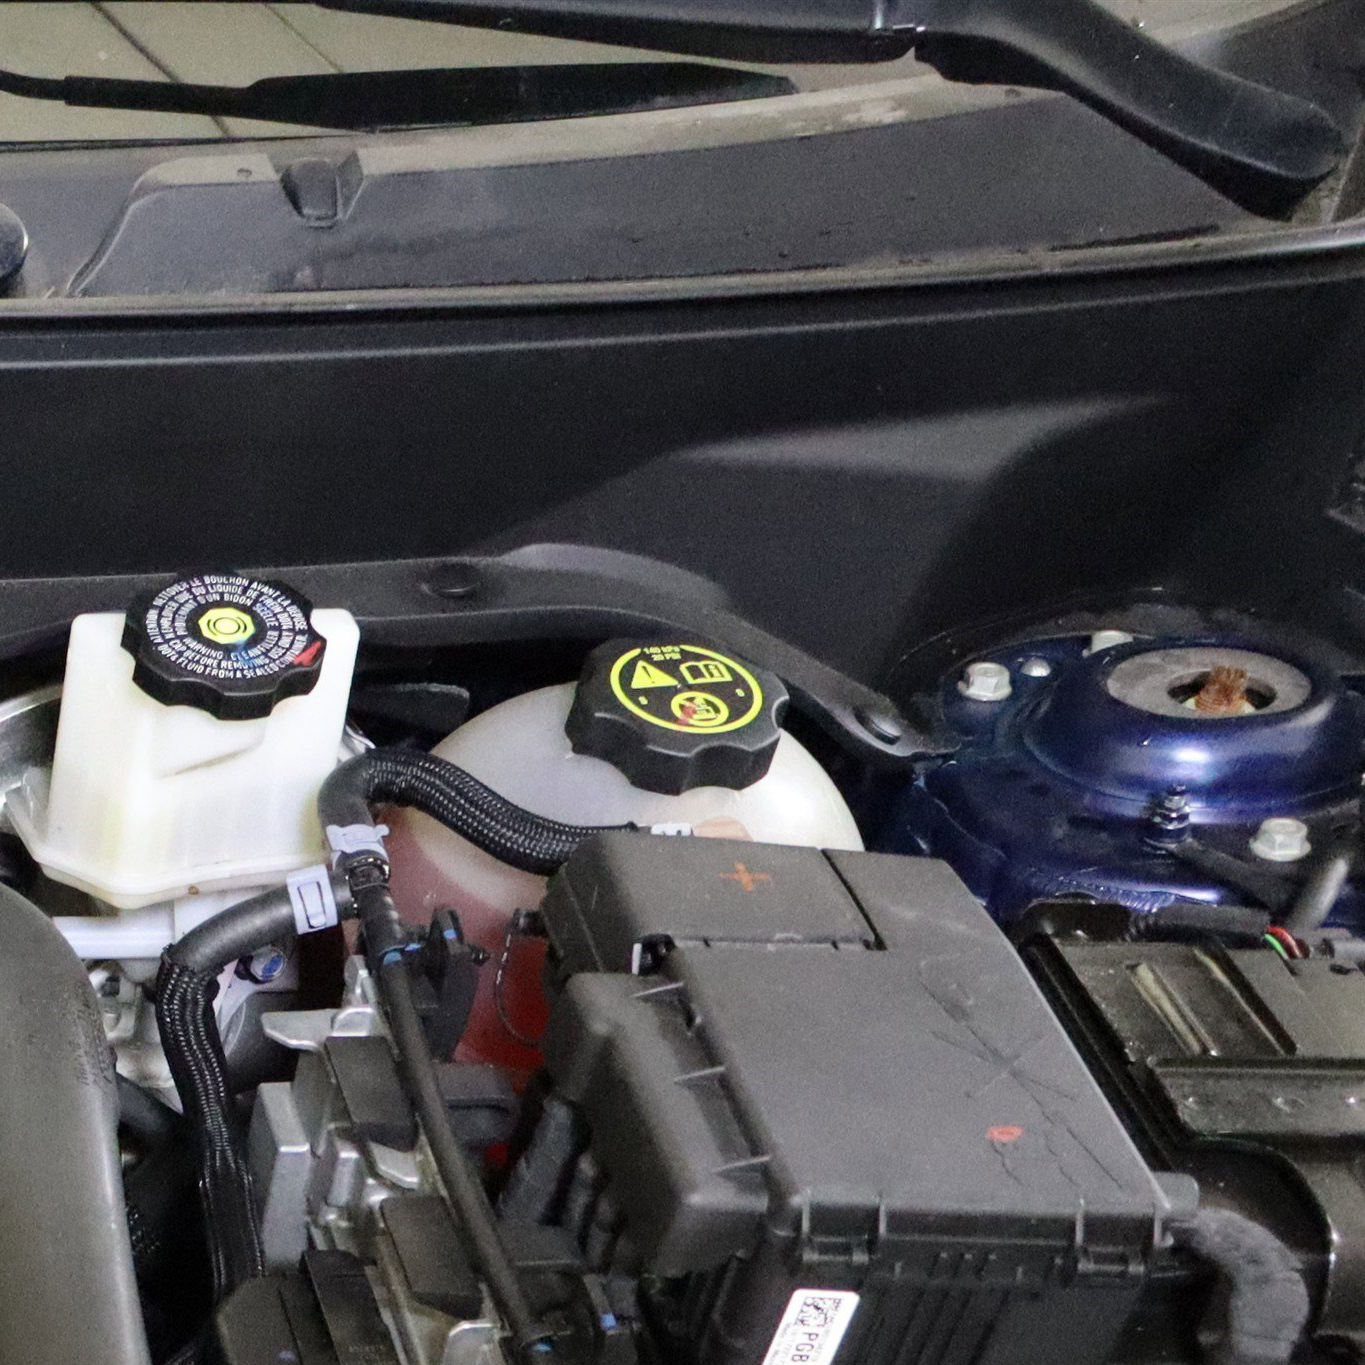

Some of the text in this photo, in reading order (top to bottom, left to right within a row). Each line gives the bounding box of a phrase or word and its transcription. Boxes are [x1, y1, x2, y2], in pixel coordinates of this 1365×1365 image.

[190, 577, 201, 586] LE
[250, 582, 280, 597] AVANT
[278, 594, 292, 606] LA
[193, 585, 205, 595] DU
[209, 585, 243, 594] LIQUIDE
[247, 589, 257, 598] DE
[259, 594, 283, 613] FREIN
[224, 593, 253, 606] BIDON
[169, 640, 186, 652] CAP
[185, 649, 218, 668] BEFORE
[176, 657, 205, 674] FLUID
[205, 667, 234, 679] FROM
[235, 669, 243, 678] A
[243, 663, 279, 679] SEALED
[791, 1331, 819, 1363] PGB
